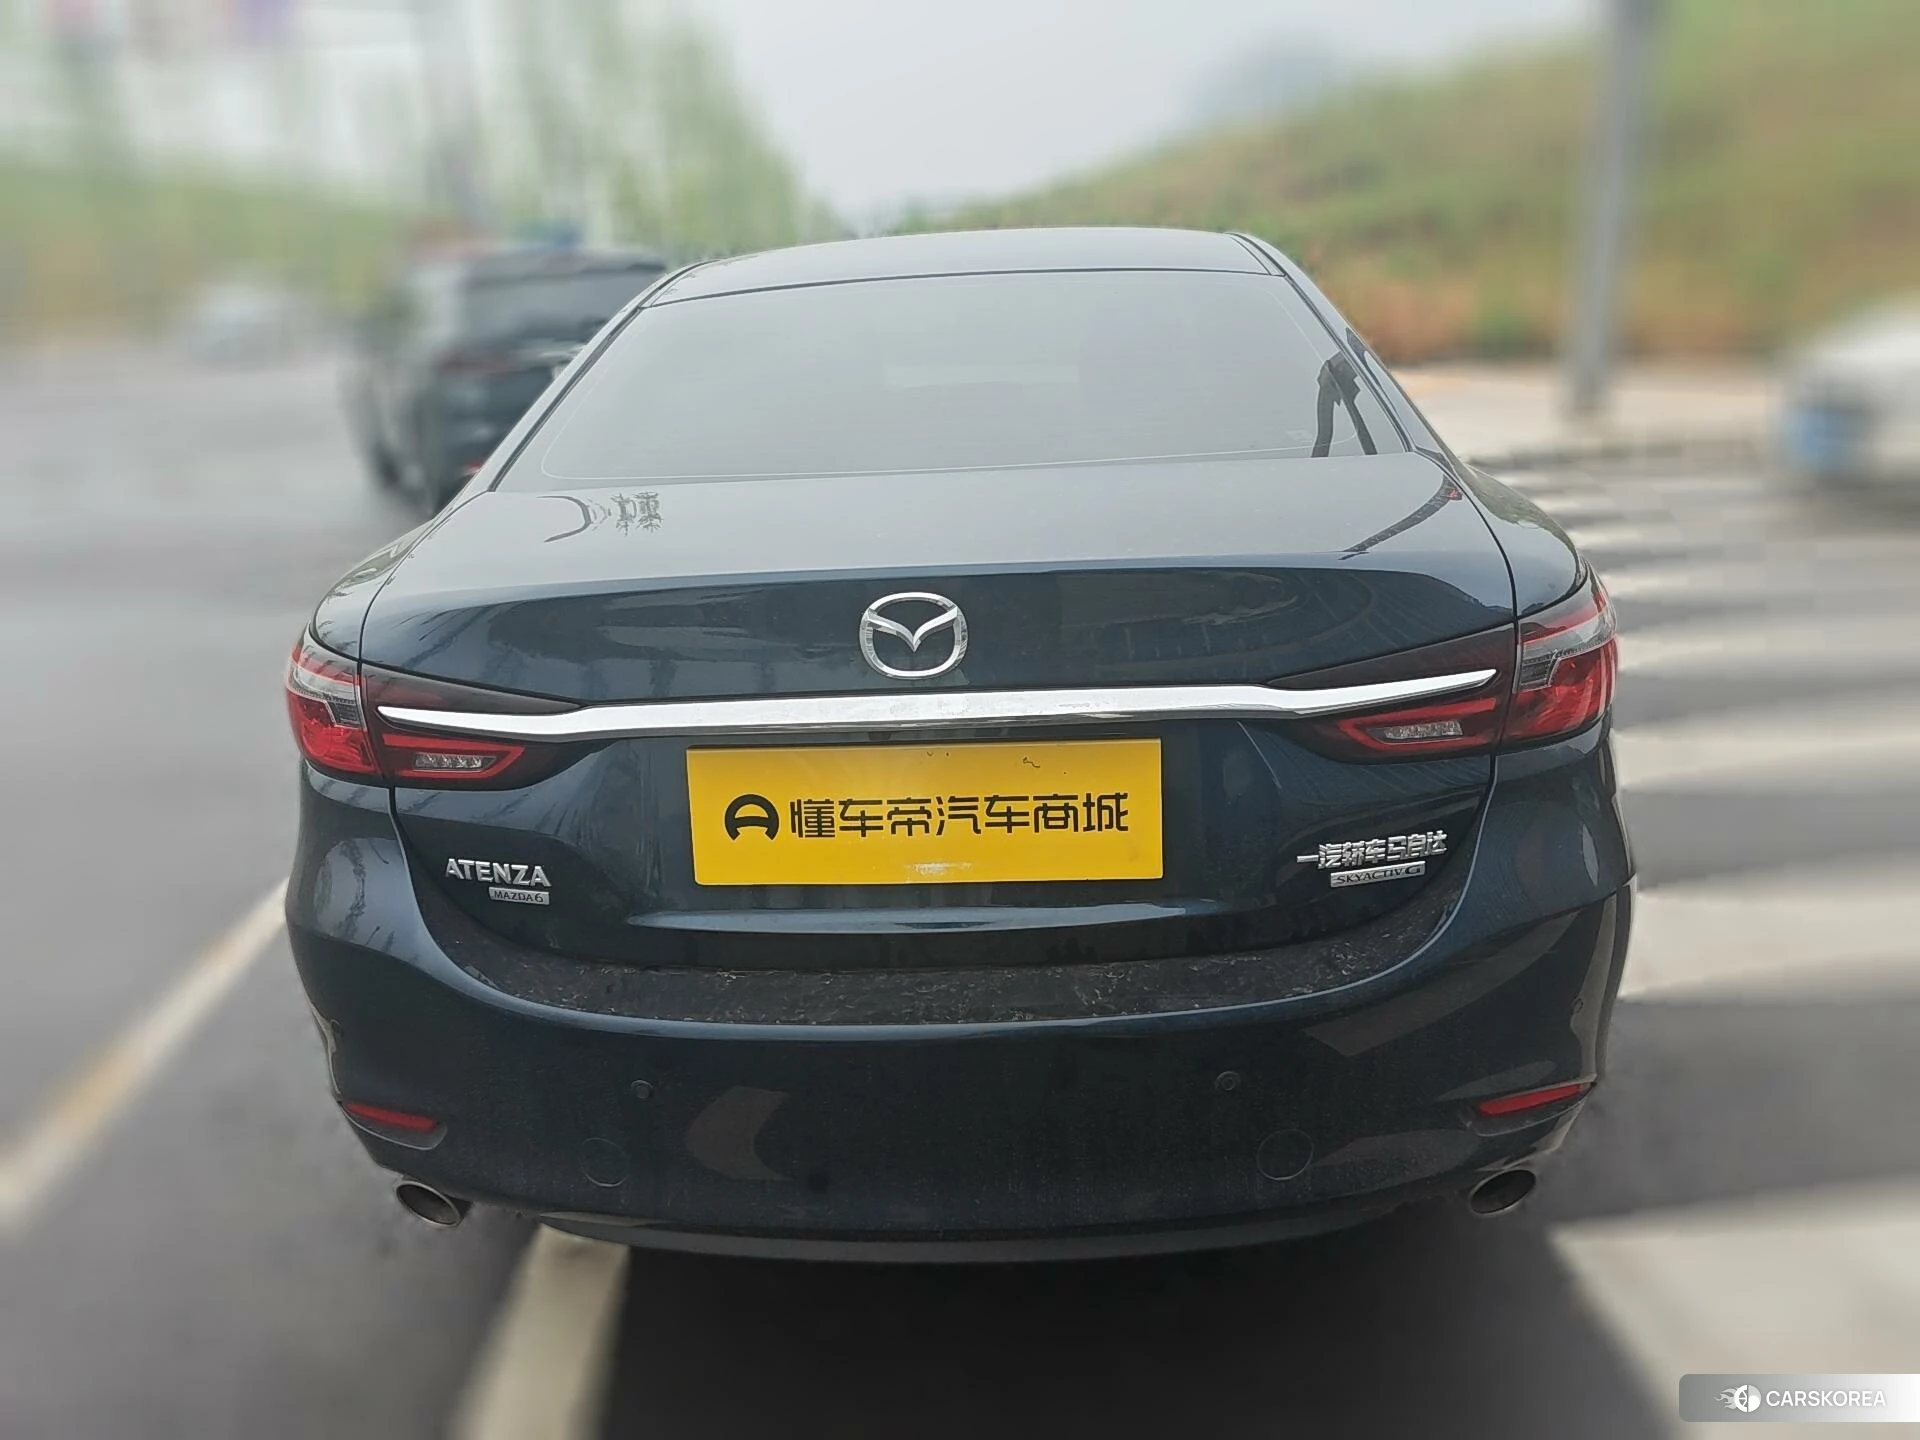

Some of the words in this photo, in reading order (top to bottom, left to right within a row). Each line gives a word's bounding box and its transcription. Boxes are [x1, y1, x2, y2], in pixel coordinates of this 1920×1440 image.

[790, 792, 1128, 838] 懂车帝汽车商城
[1296, 829, 1447, 869] 一汽轿车马自达
[445, 858, 552, 887] ATENZA
